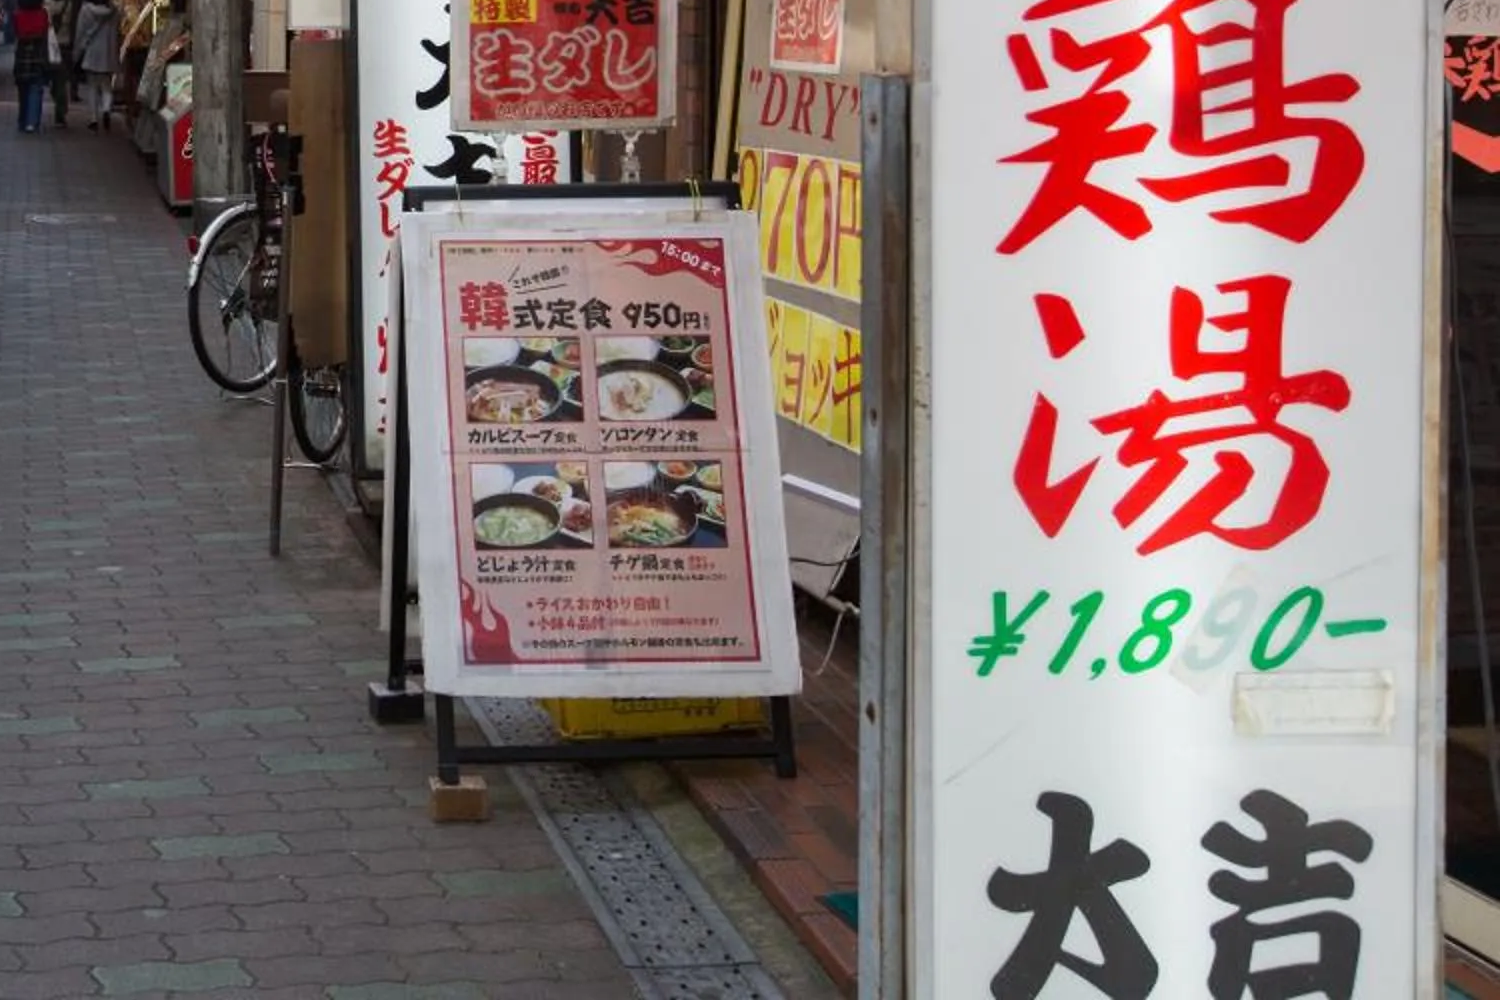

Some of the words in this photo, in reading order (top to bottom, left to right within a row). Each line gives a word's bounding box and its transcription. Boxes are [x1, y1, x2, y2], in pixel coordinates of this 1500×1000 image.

[459, 281, 612, 332] 韓式定食
[622, 302, 701, 329] 950円
[986, 788, 1376, 1000] 大吉
